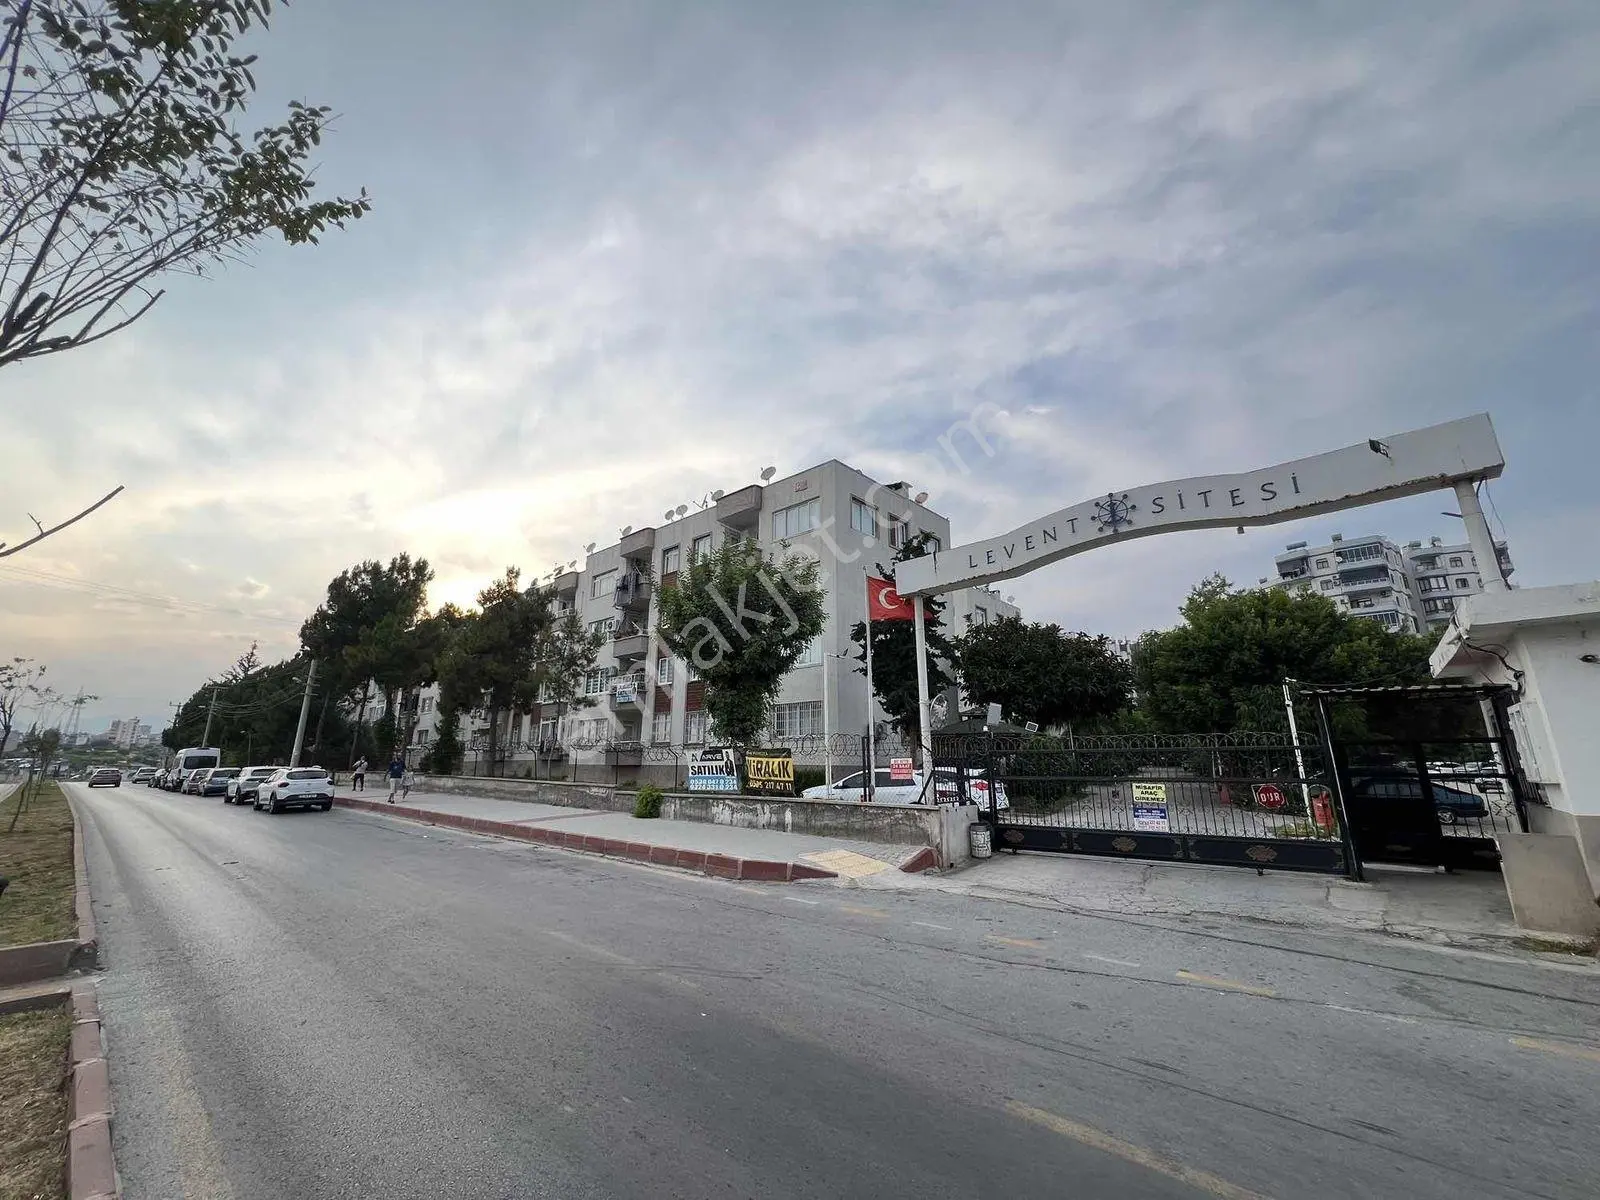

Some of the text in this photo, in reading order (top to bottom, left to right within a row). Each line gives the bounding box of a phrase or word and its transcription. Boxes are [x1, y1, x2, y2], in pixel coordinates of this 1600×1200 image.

[968, 472, 1301, 569] LEVENT SİTESİ
[691, 765, 725, 776] SATILIK
[1260, 792, 1280, 801] DUR
